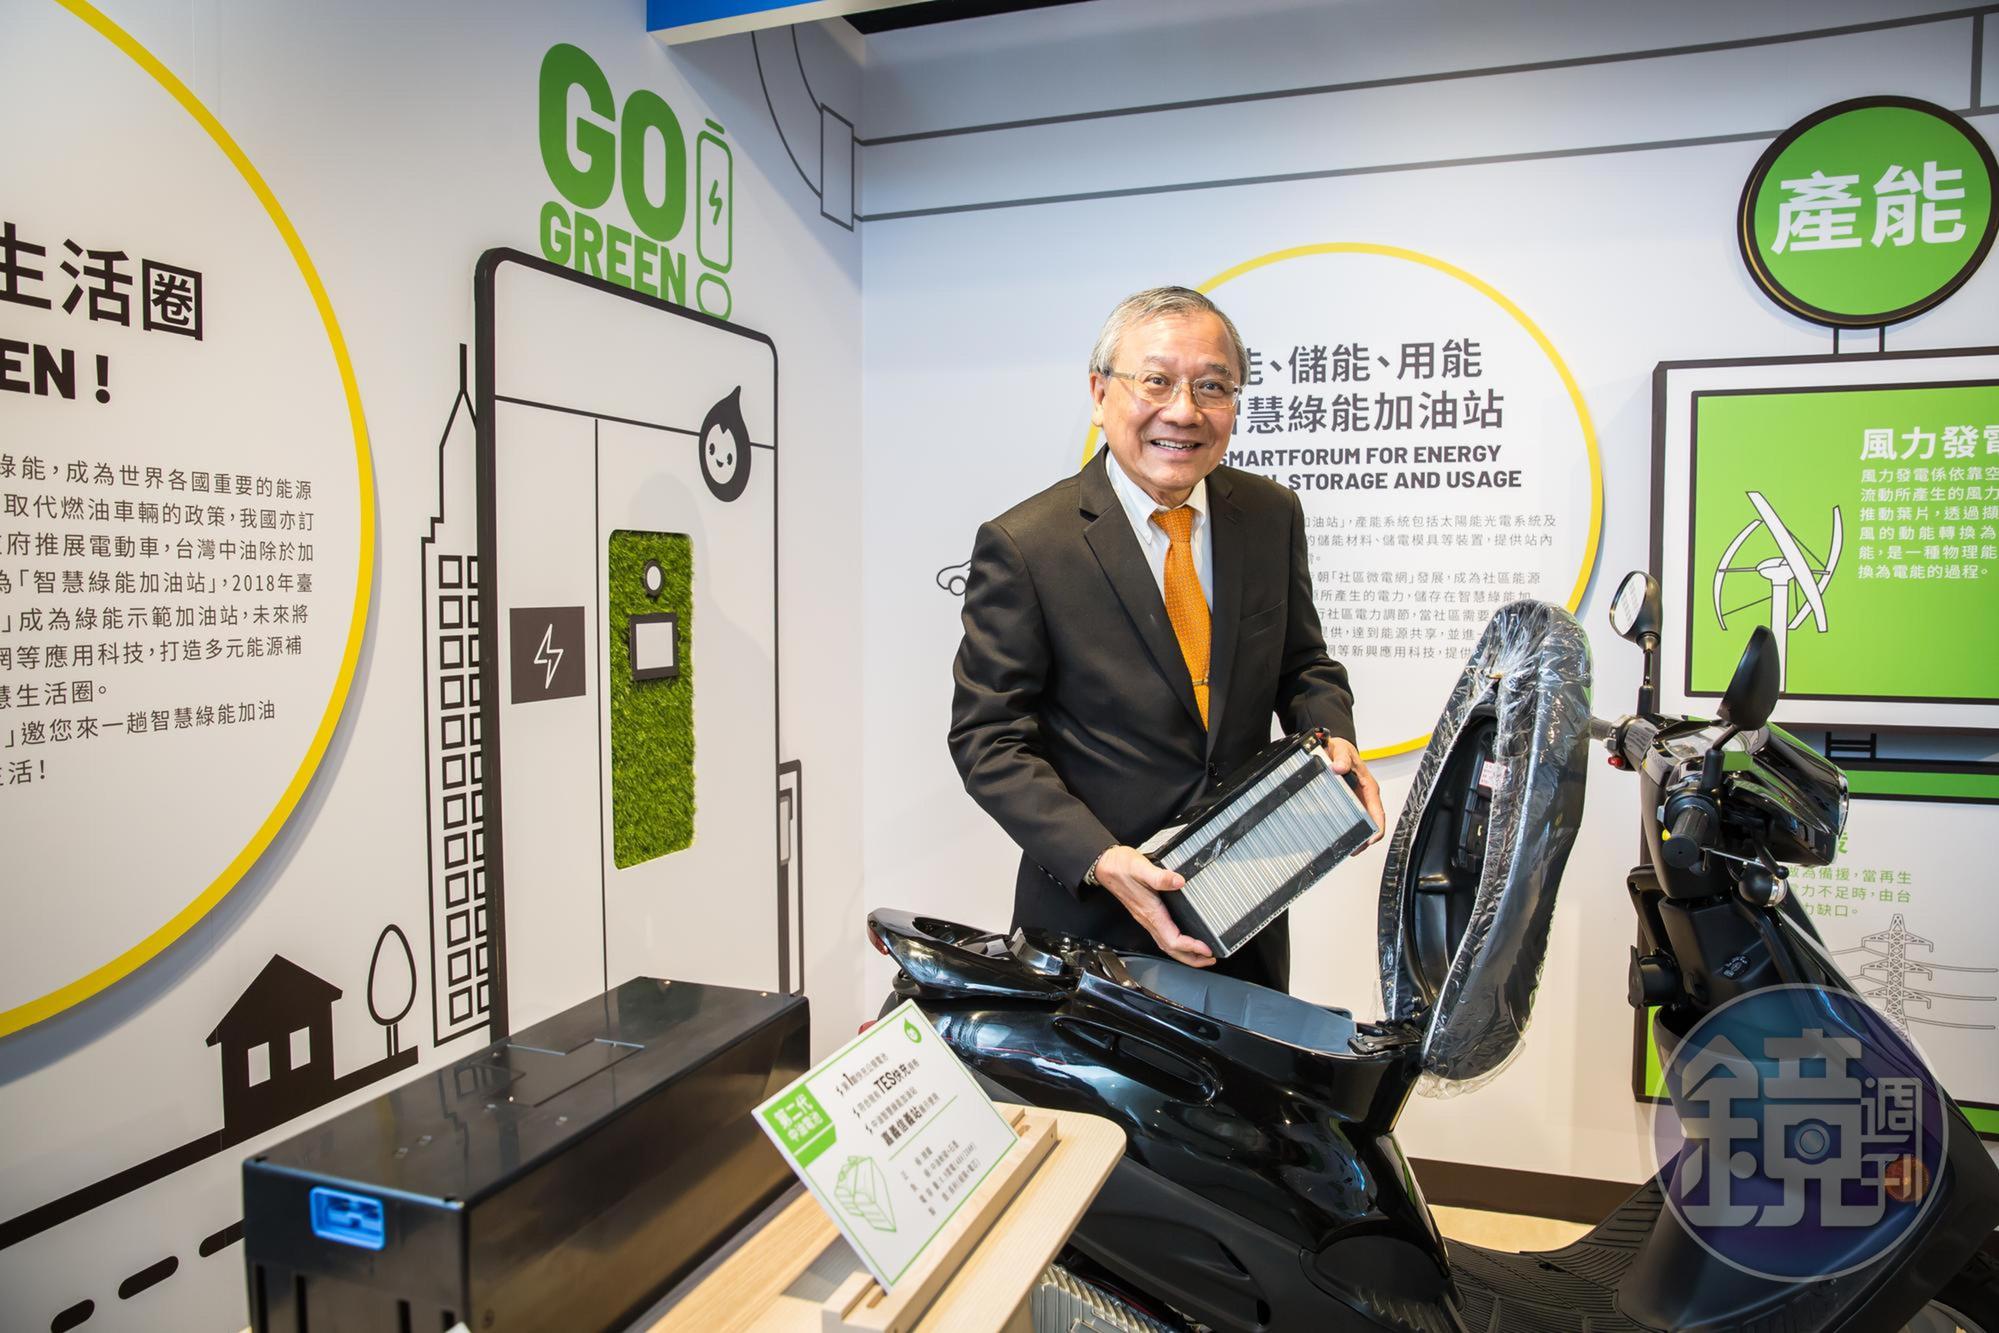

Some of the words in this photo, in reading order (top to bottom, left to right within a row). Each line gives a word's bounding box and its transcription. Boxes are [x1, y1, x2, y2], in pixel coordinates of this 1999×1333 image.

[539, 43, 687, 242] GO
[1771, 161, 1967, 255] 產能
[540, 201, 687, 308] GREEN
[0, 221, 203, 341] 生活圈
[1231, 388, 1504, 435] 慧綠能加油站
[1366, 446, 1408, 465] FOR
[1413, 445, 1502, 464] ENERGY
[1289, 472, 1388, 491] STORAGE
[1394, 472, 1440, 489] AND
[1446, 470, 1522, 489] USAGE
[4, 493, 314, 531] 取代燃油車輛的政策，我國亦訂
[0, 531, 314, 562] 府推展電動車，台灣中油除於加
[1312, 571, 1541, 584] 朝「社區微電網」發展，成為社區能源
[0, 759, 46, 786] 活！
